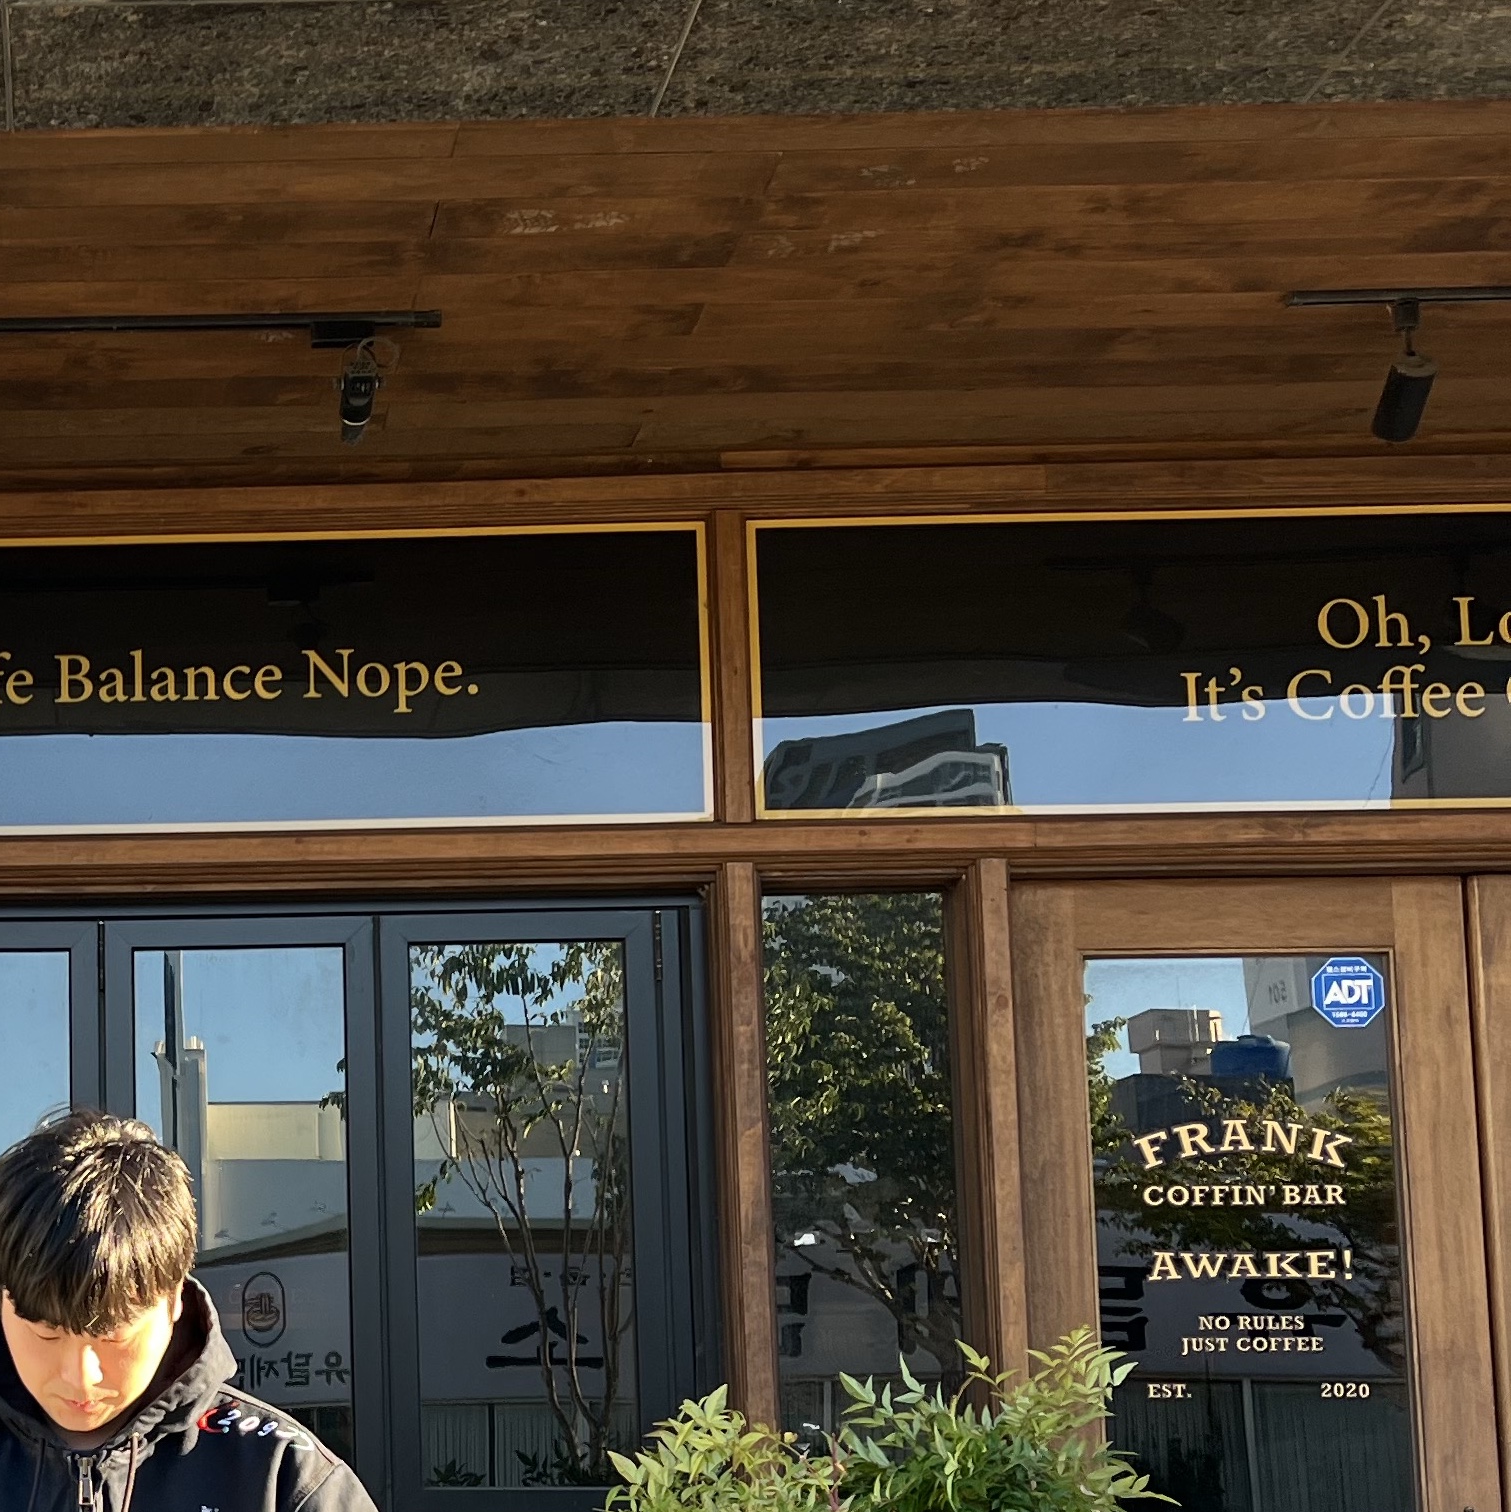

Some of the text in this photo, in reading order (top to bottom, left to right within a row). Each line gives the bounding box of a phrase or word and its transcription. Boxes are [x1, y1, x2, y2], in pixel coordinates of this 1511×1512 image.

[1317, 594, 1431, 655] Oh,
[54, 648, 283, 703] Balance
[302, 648, 480, 713] Nope.
[1286, 663, 1486, 720] Coffee
[1324, 979, 1373, 1004] ADT
[1134, 1119, 1354, 1170] FRANK
[1283, 1185, 1347, 1206] BAR
[1148, 1250, 1353, 1281] AWAKE!
[1198, 1315, 1305, 1332] NO RULES
[1181, 1336, 1324, 1356] JUST COFFEE
[1148, 1383, 1193, 1399] EST.
[1321, 1382, 1371, 1399] 2020
